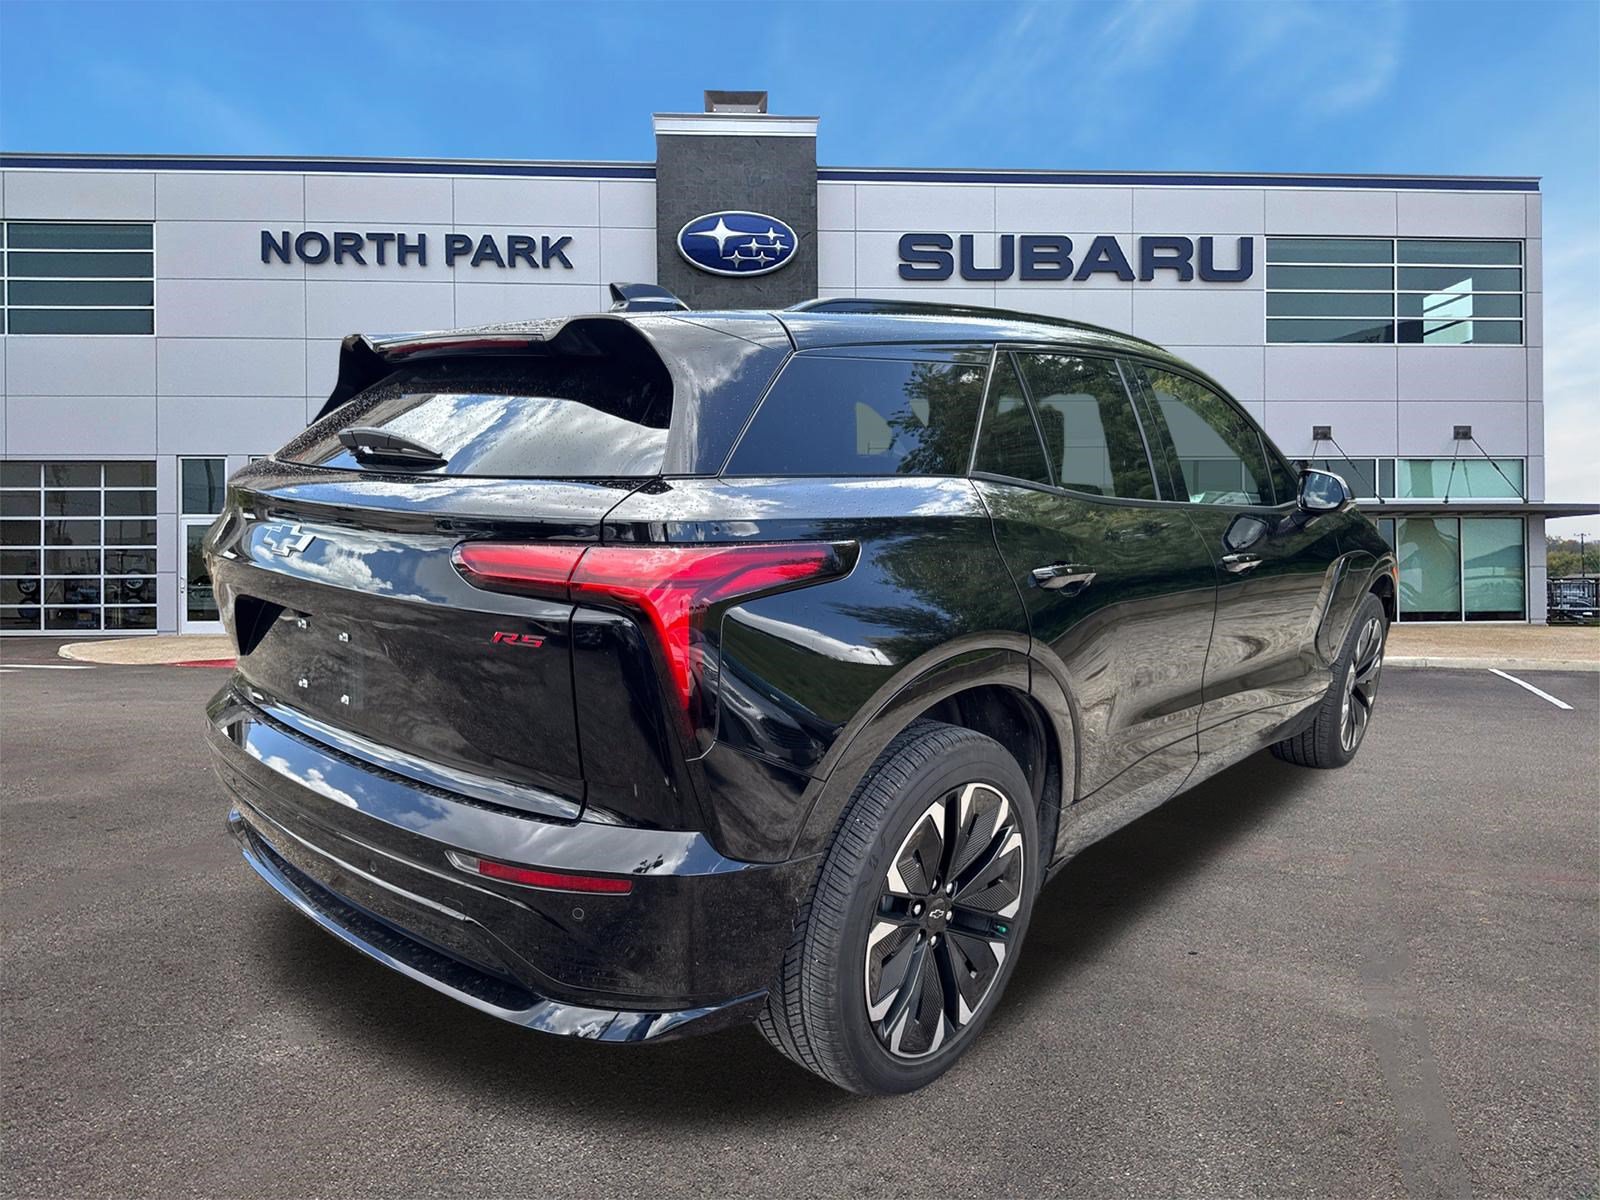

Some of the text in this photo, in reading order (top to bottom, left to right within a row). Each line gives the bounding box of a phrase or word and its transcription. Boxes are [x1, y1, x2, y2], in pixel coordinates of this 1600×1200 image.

[261, 230, 574, 269] NORTH PARK
[898, 233, 1254, 282] SUBARU
[491, 631, 546, 648] RS
